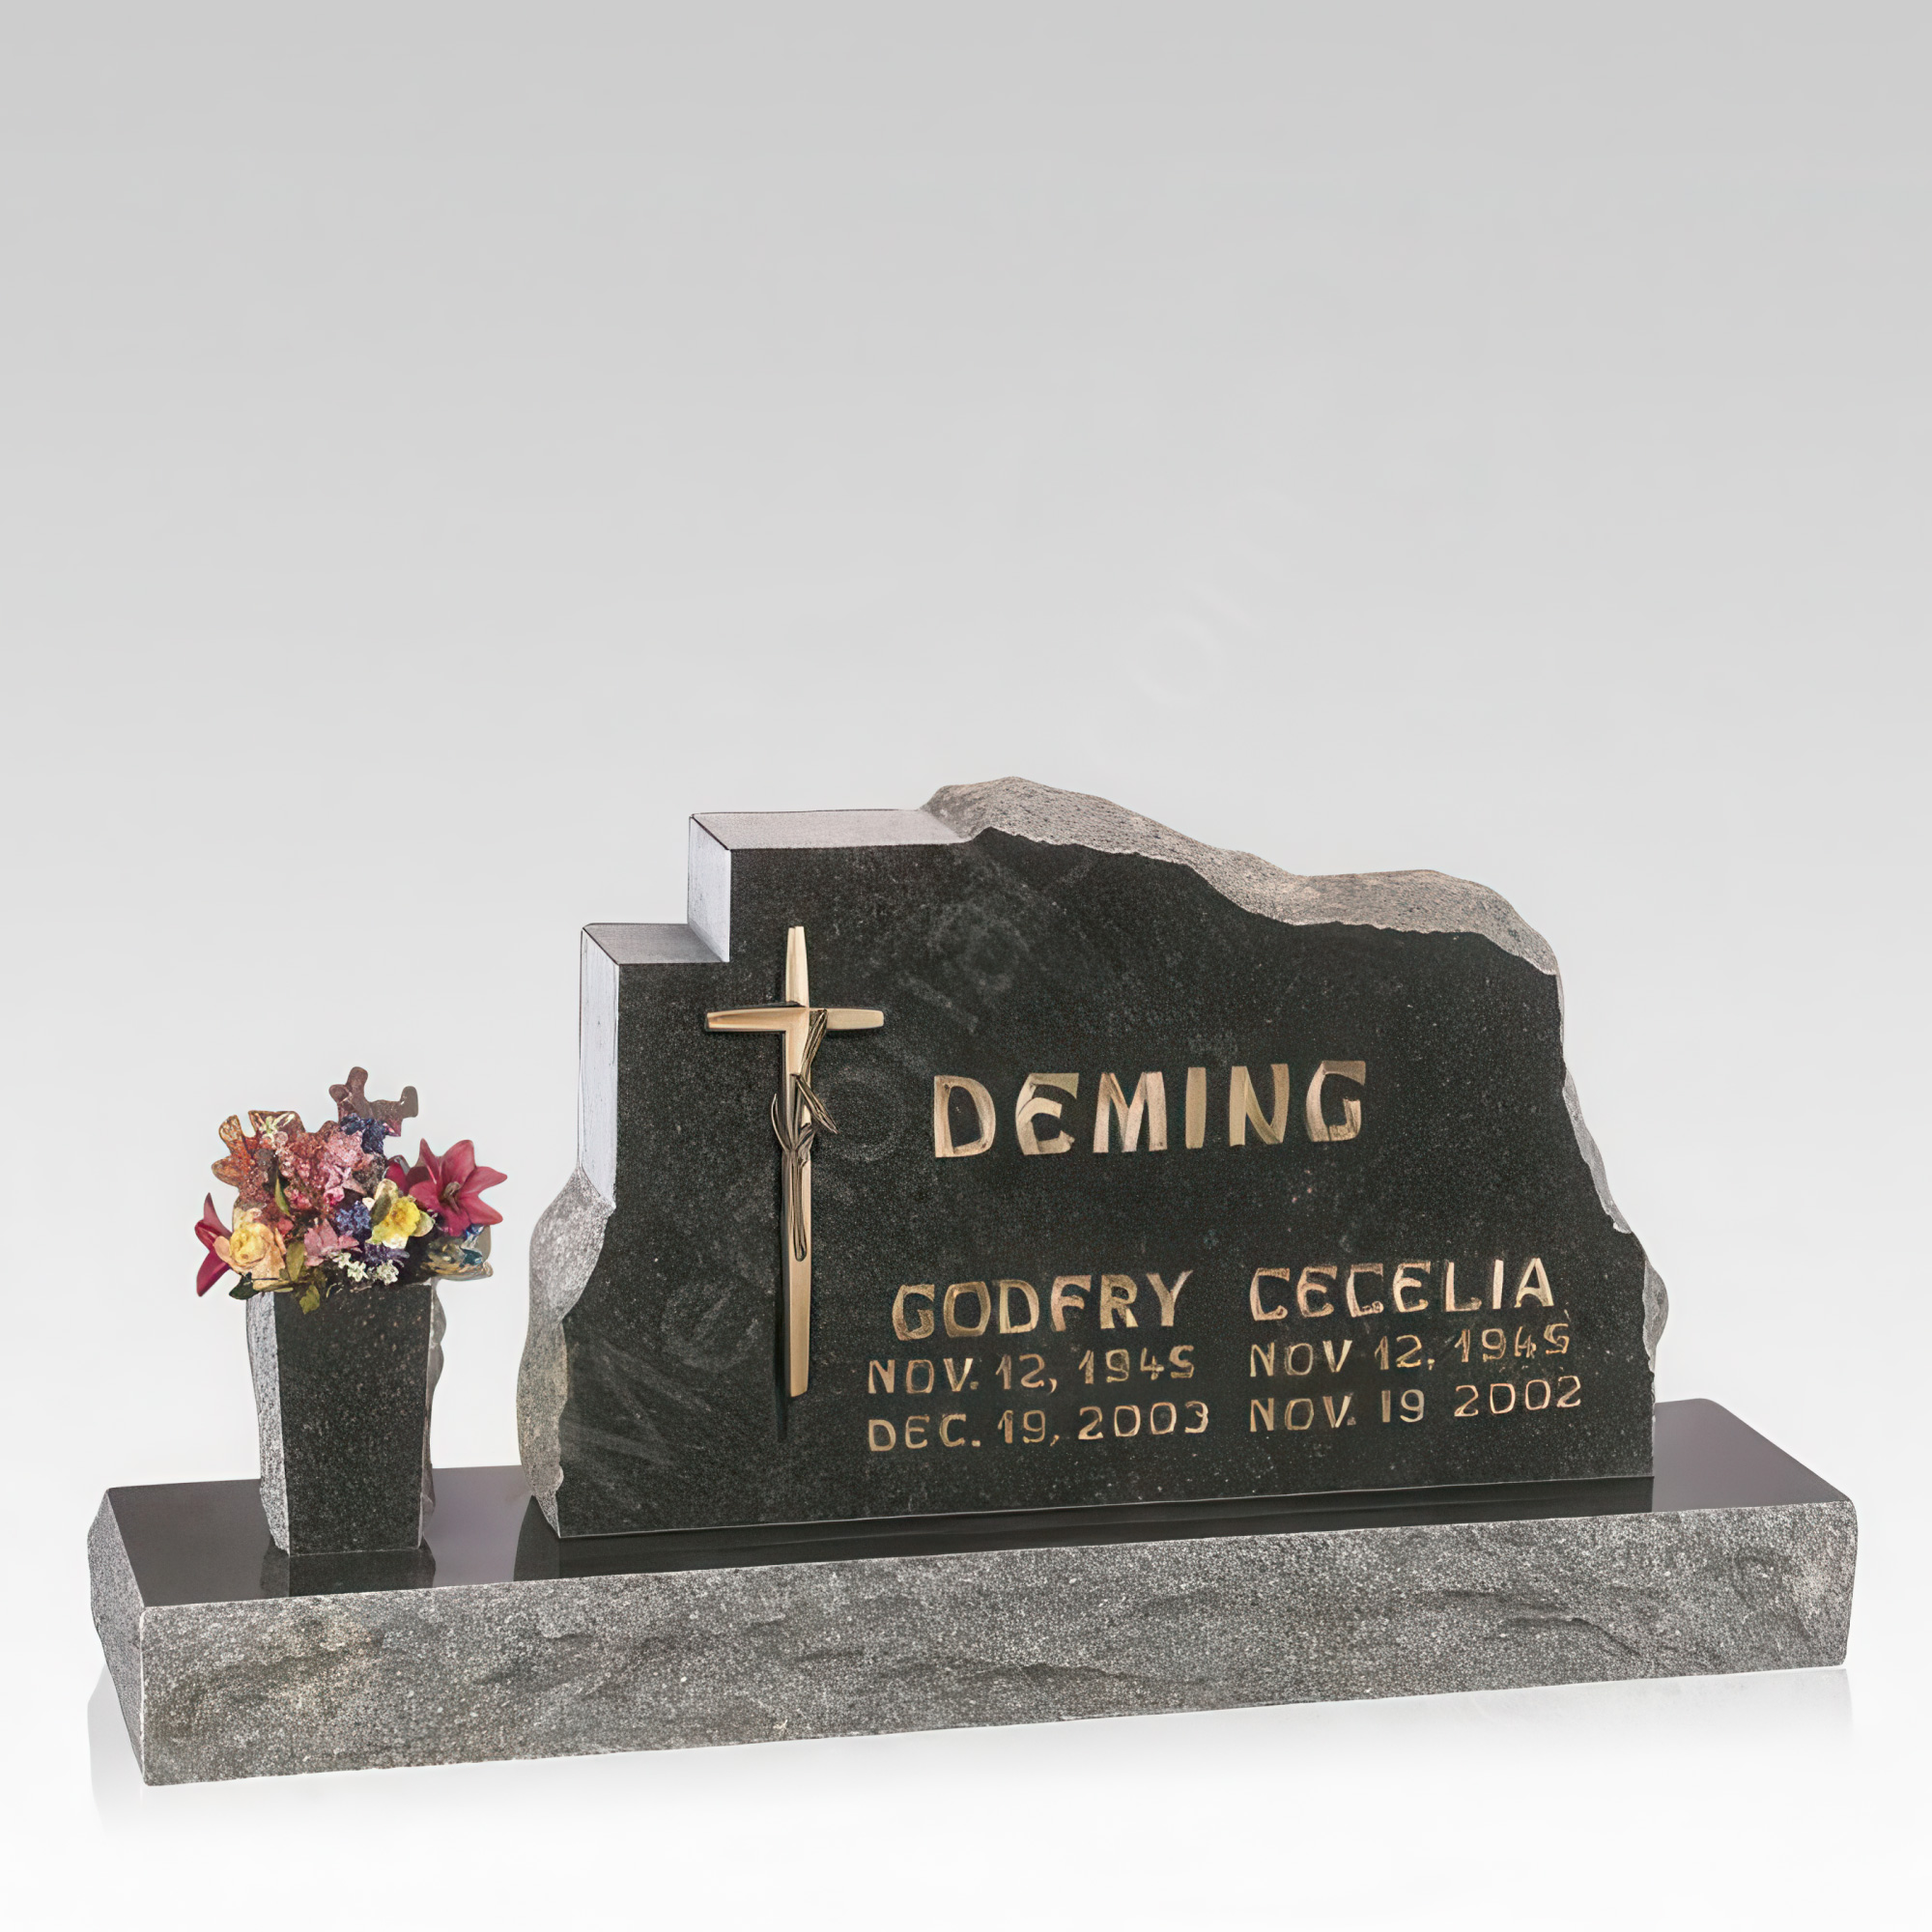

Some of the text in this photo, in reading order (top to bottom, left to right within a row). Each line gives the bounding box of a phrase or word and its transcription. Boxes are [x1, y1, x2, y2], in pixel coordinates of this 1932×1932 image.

[934, 1061, 1366, 1158] DEMING
[892, 1270, 1194, 1341] GODFRY
[1249, 1258, 1554, 1321] CECELIA
[868, 1345, 1195, 1394] NOV. 12, 1945
[1249, 1339, 1353, 1378] NOV
[868, 1401, 1209, 1452] DEC. 19, 2003
[1249, 1375, 1581, 1433] NOV. 19 2002
